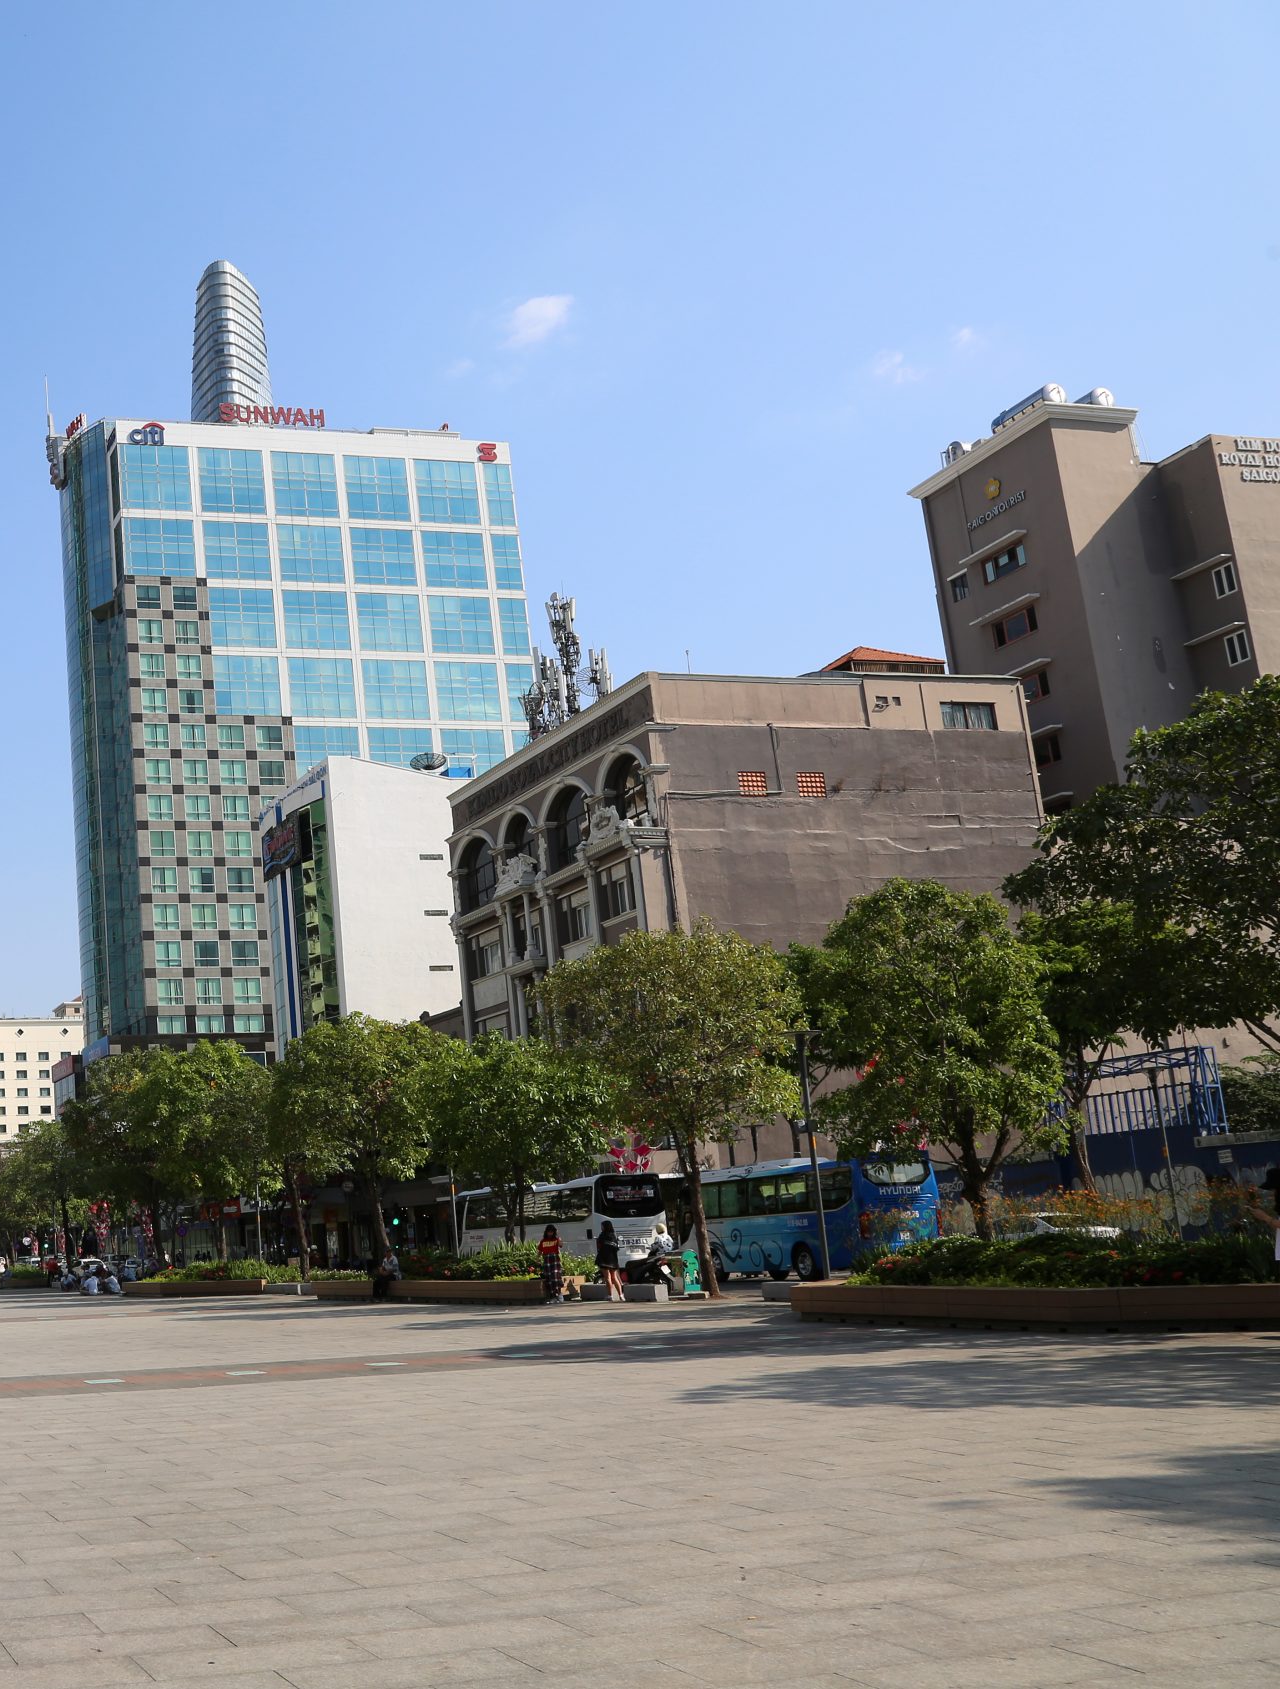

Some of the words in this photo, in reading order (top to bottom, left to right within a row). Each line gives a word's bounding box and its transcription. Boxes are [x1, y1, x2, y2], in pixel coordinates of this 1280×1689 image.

[219, 402, 326, 427] SUNWAH
[130, 423, 165, 446] citi
[1235, 438, 1263, 451] KIM
[1220, 452, 1263, 466] ROYAL
[577, 708, 628, 753] HOTEL
[879, 1185, 922, 1196] HYUNDAI
